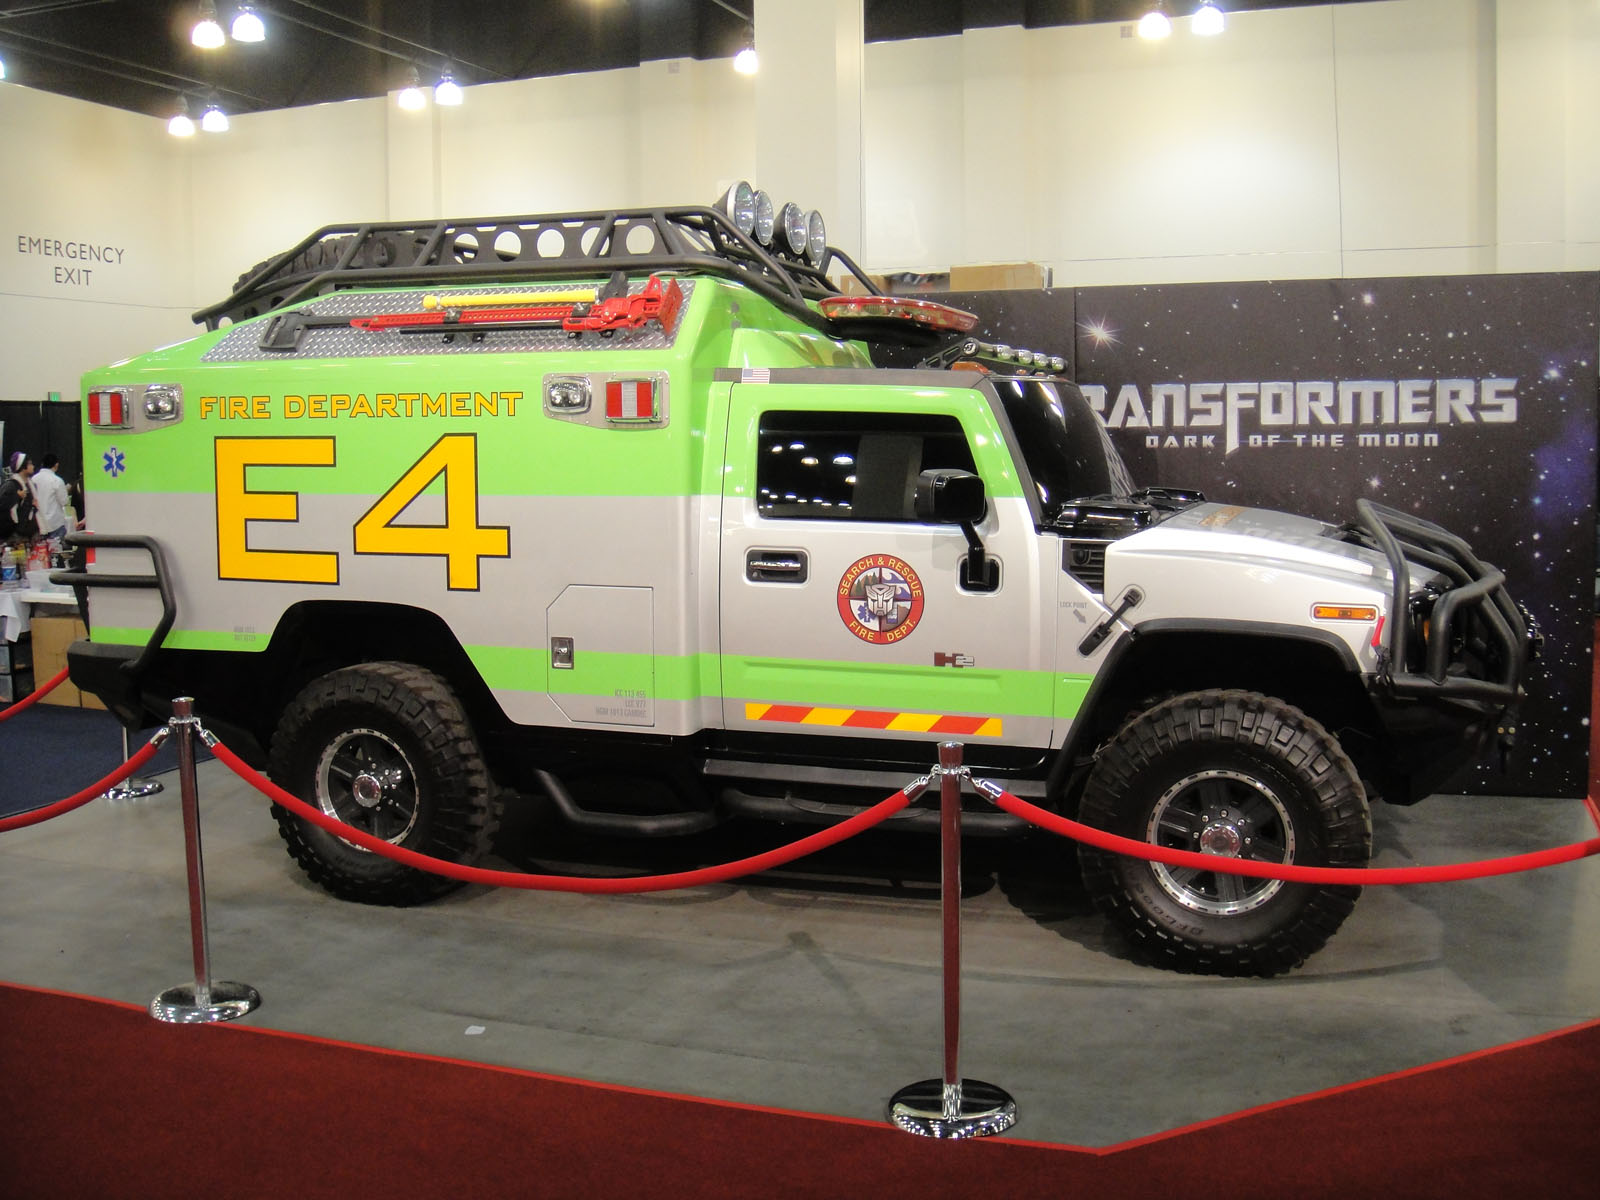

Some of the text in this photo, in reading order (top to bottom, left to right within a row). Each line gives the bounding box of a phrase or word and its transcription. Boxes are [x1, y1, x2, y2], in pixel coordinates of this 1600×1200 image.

[17, 235, 125, 264] EMERGENCY
[54, 266, 93, 286] EXIT
[200, 391, 524, 419] FIRE DEPARTMENT
[1145, 433, 1439, 448] DARK OF THE MOON
[214, 432, 512, 592] E4
[840, 556, 922, 597] SEARCH & RESCUE
[849, 620, 875, 641] FIRE
